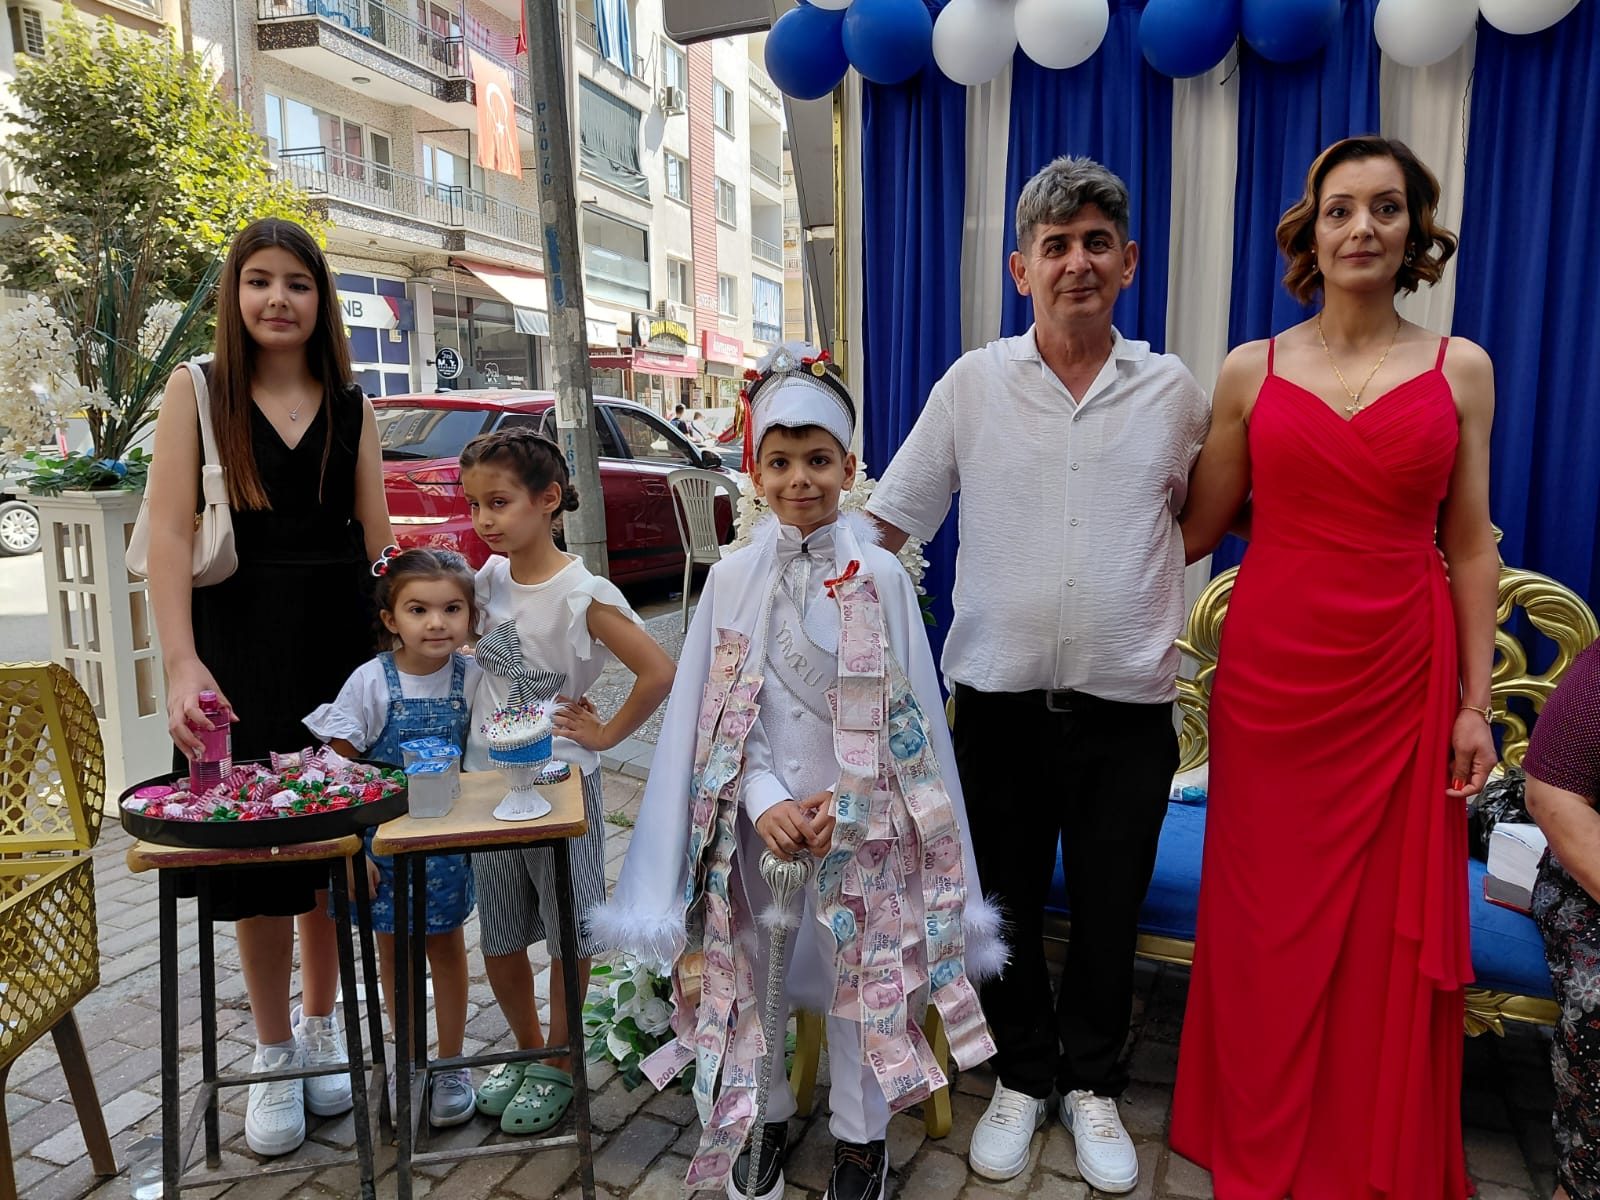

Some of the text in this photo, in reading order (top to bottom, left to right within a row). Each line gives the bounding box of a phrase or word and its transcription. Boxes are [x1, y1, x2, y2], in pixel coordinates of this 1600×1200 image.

[871, 707, 881, 727] 200
[866, 731, 875, 744] 20
[838, 793, 850, 817] 100
[925, 852, 936, 870] 200
[889, 893, 901, 917] 200
[927, 914, 938, 936] 100
[703, 974, 711, 995] 200
[754, 1034, 764, 1053] 200
[980, 1035, 994, 1055] 200
[871, 1051, 887, 1075] 200
[657, 1067, 675, 1087] 200
[928, 1066, 944, 1085] 200
